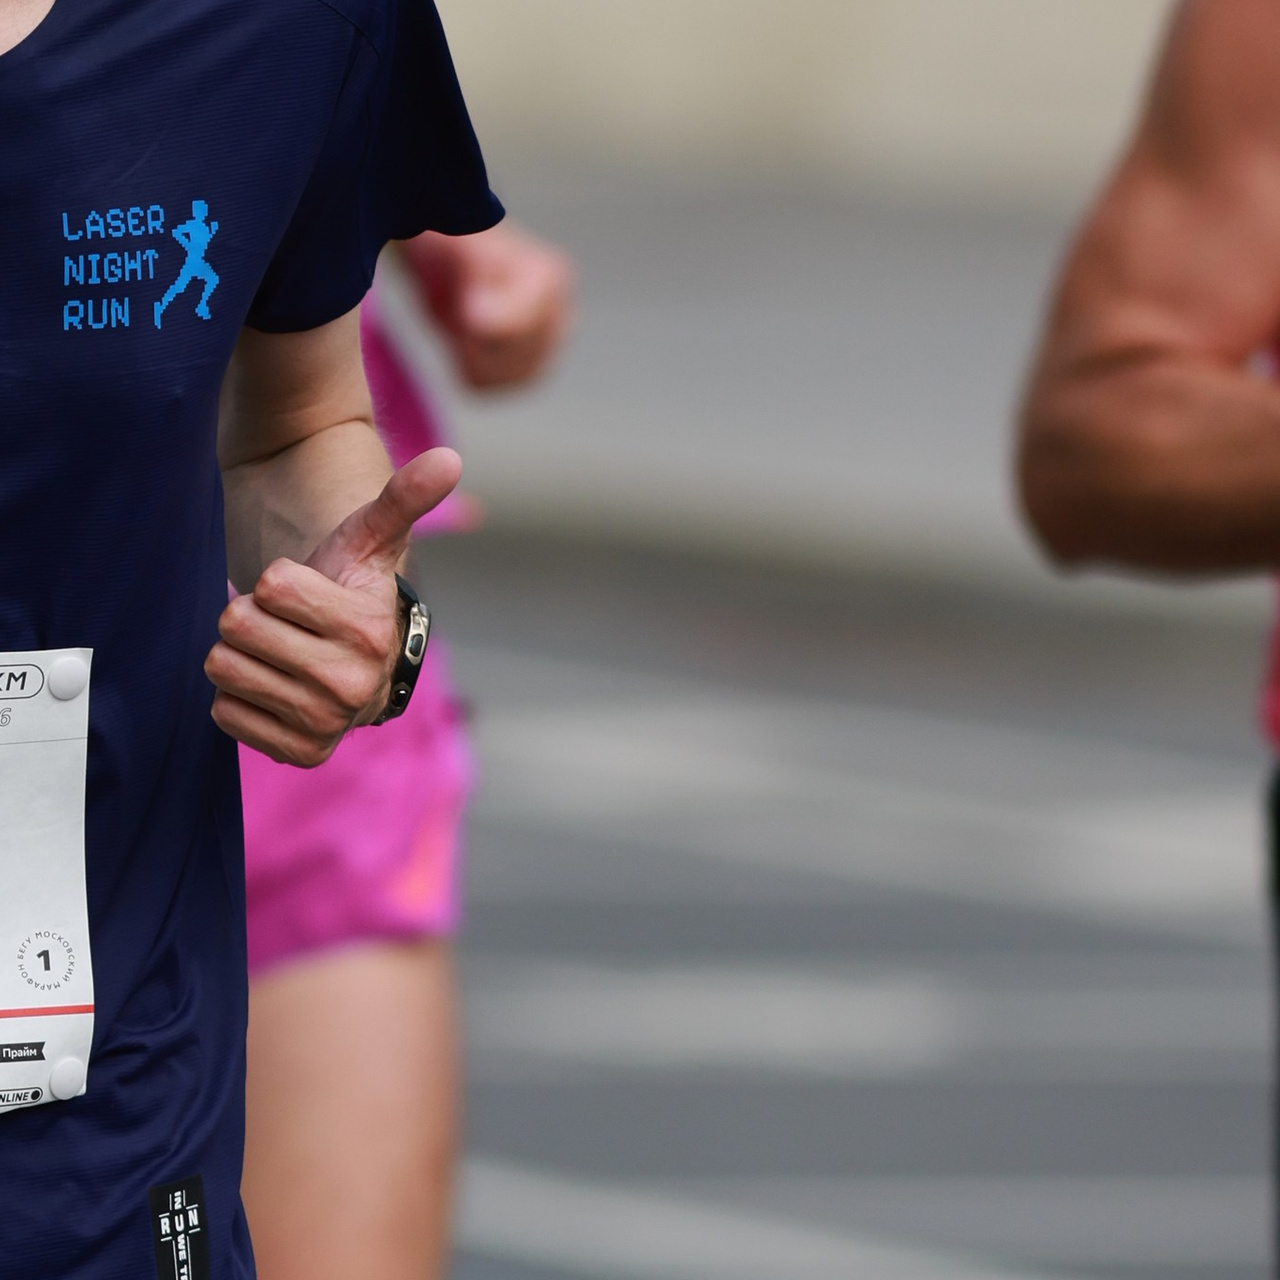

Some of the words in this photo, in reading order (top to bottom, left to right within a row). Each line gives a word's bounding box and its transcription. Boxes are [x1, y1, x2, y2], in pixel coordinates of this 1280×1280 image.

[62, 205, 164, 241] LASER
[63, 249, 159, 286] NIGHT
[63, 297, 130, 331] RUN
[37, 950, 51, 971] 1
[2, 1047, 37, 1059] Прайм
[160, 1208, 199, 1235] RUN
[177, 1233, 187, 1261] WE
